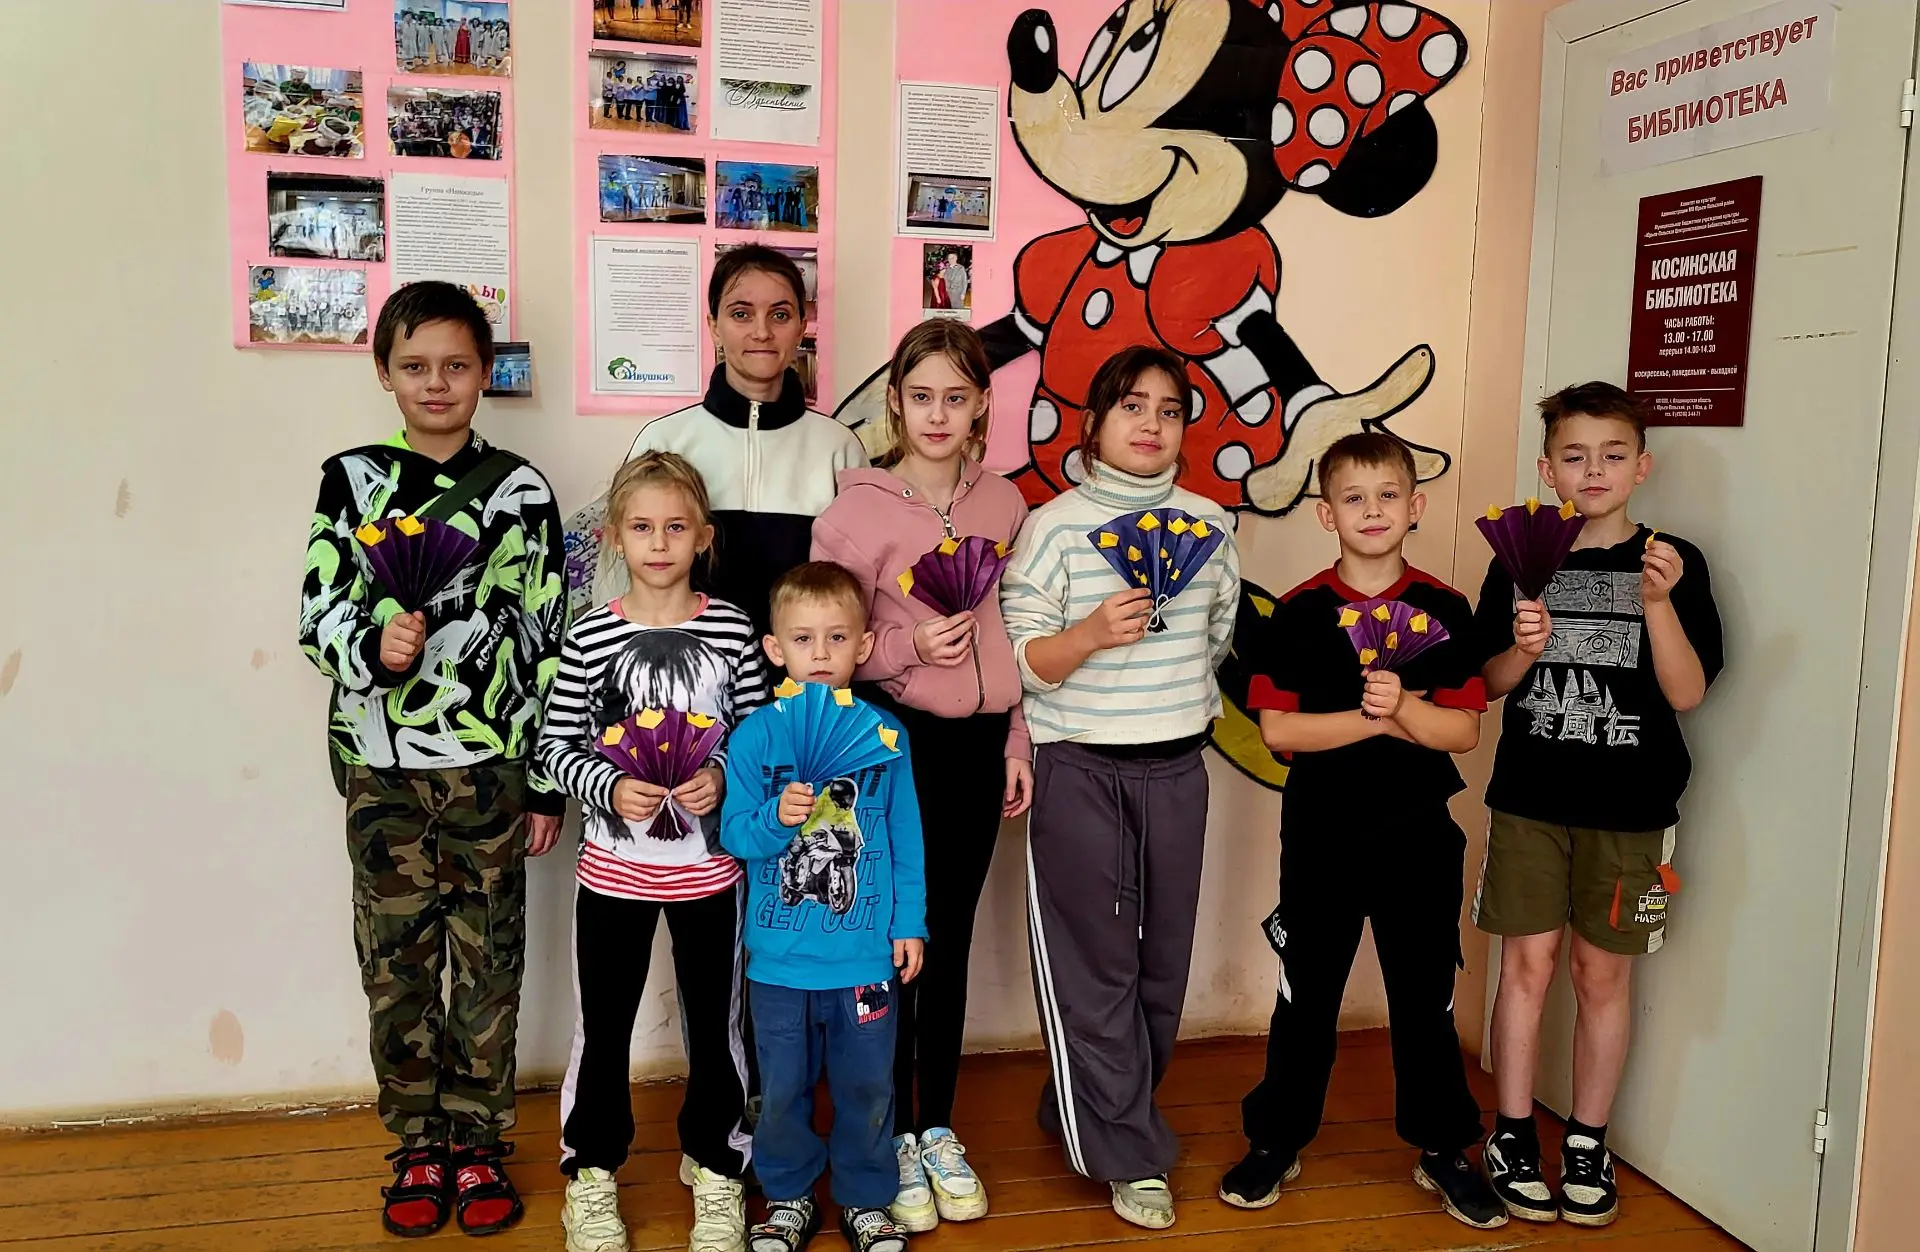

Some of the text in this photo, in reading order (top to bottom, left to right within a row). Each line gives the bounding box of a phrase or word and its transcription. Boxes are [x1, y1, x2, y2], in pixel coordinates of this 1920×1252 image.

[1610, 16, 1818, 96] Вас приветствует
[1628, 78, 1788, 143] БИБЛИОТЕКА
[1651, 249, 1737, 280] КОСИНСКАЯ
[1645, 280, 1738, 310] БИБЛИОТЕКА
[1664, 315, 1715, 329] ЧАСЫ РАБОТЫ:
[1664, 331, 1685, 344] 13.00
[1692, 329, 1714, 342] 17.00
[1659, 347, 1683, 357] перерыв
[1634, 368, 1671, 379] воскресенье,
[1672, 367, 1707, 377] понедельник
[1711, 365, 1738, 376] выходной
[756, 893, 817, 932] GET
